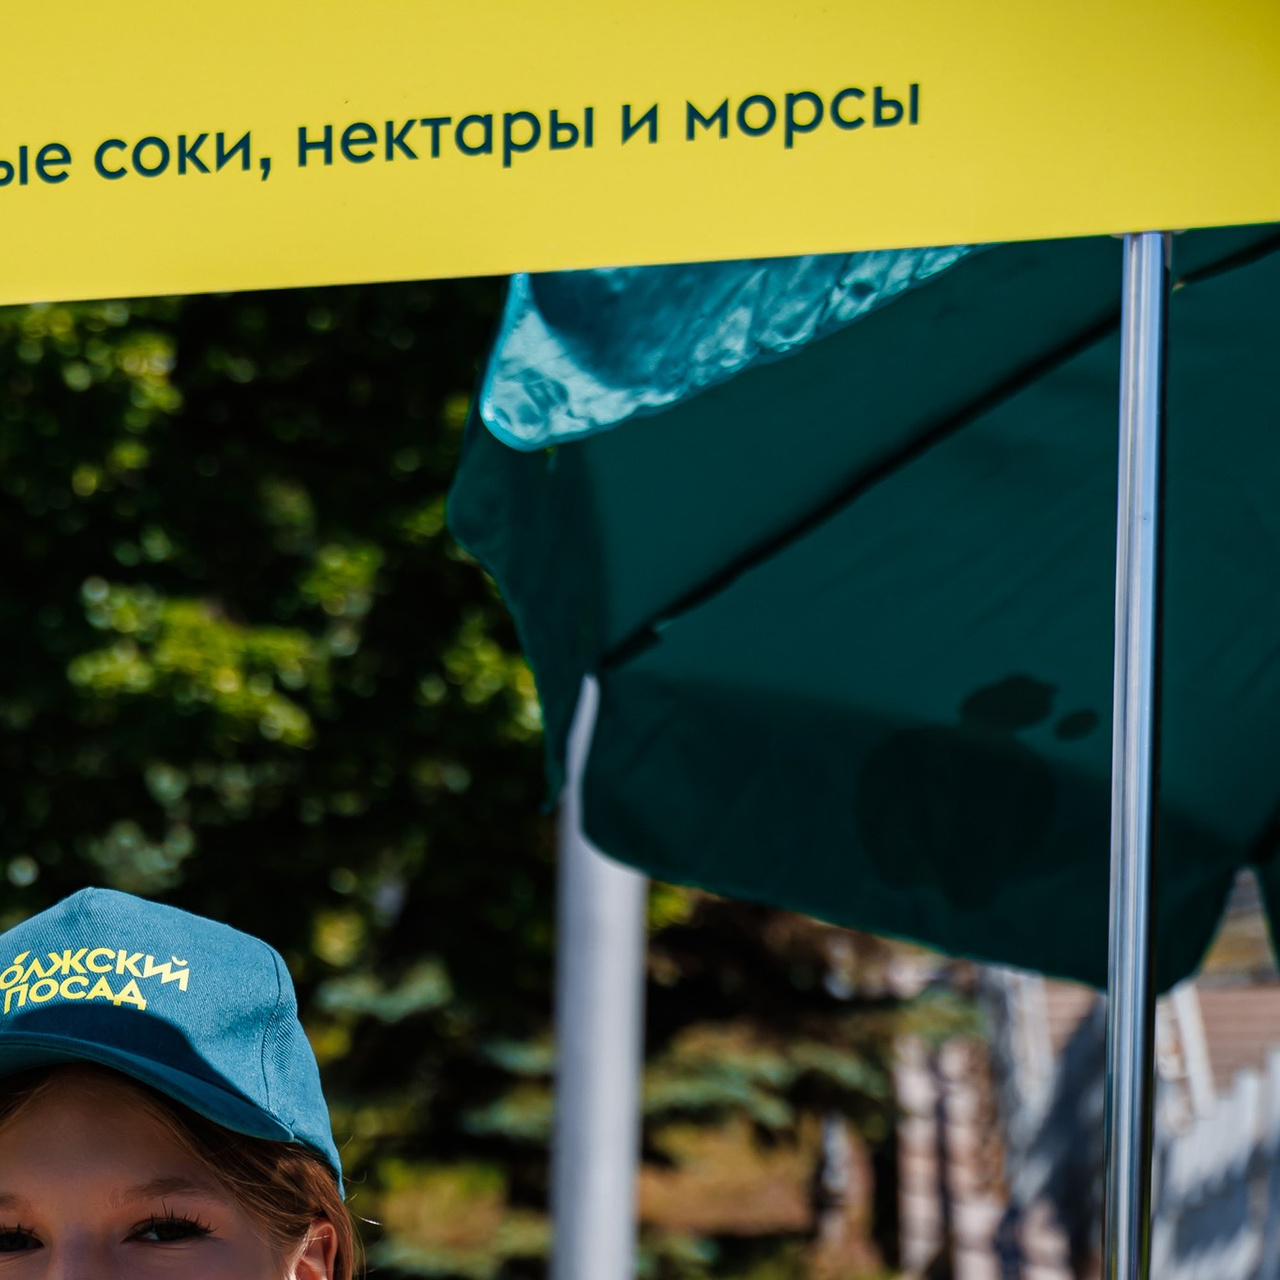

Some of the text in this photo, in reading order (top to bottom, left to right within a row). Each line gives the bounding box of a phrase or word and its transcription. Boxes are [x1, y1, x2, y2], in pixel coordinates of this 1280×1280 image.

[94, 131, 270, 180] соки,
[298, 106, 593, 167] нектары
[621, 103, 657, 143] и
[686, 83, 918, 148] морсы
[4, 975, 147, 1015] ПОСАД
